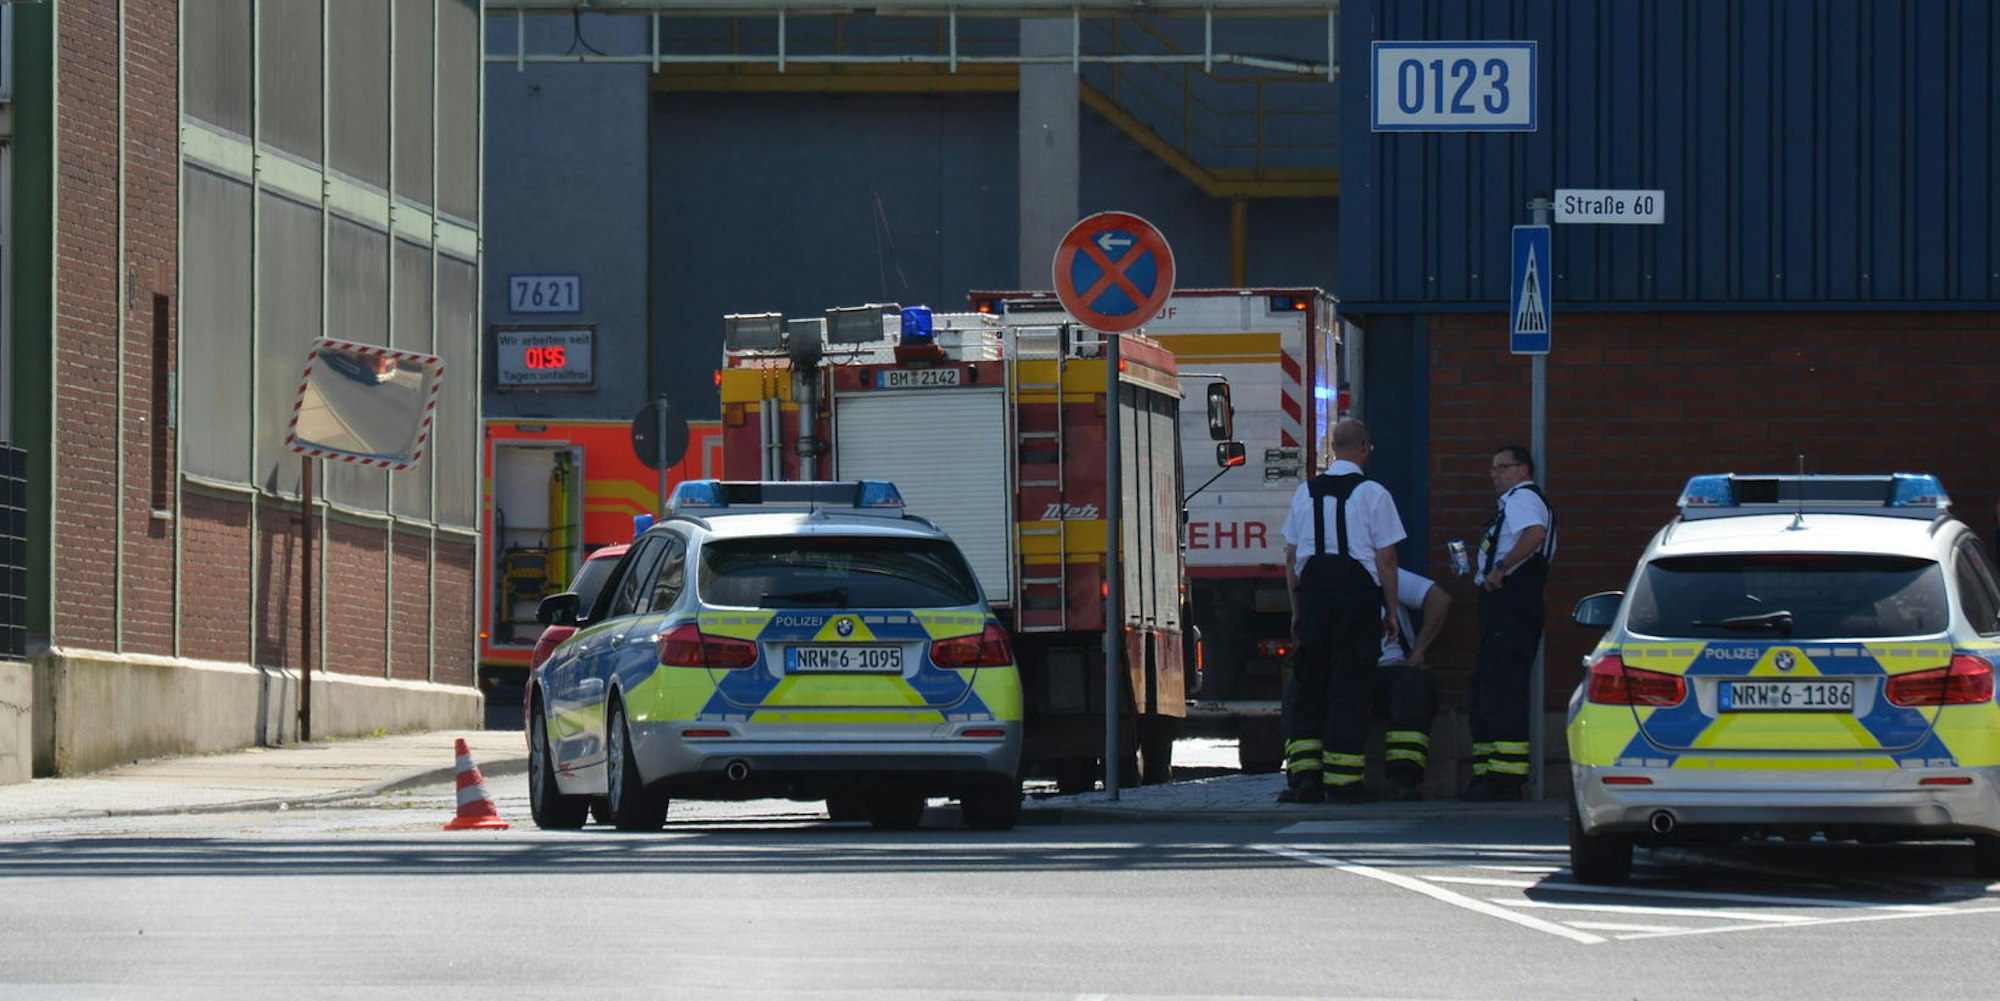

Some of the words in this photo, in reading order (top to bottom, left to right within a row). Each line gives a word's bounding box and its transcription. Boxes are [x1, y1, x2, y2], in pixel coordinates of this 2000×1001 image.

[1398, 58, 1510, 114] 0123
[1564, 195, 1625, 215] Straße
[1633, 195, 1654, 215] 60
[517, 281, 574, 307] 7621
[890, 372, 908, 385] BM
[921, 371, 956, 384] 2142
[1041, 503, 1099, 521] Metz
[776, 616, 823, 626] POLIZEI
[797, 650, 829, 668] NRW
[840, 650, 900, 668] 6-1095
[1705, 648, 1759, 659] POLIZEI
[1732, 685, 1769, 705] NRW
[1781, 685, 1850, 705] 6-1186
